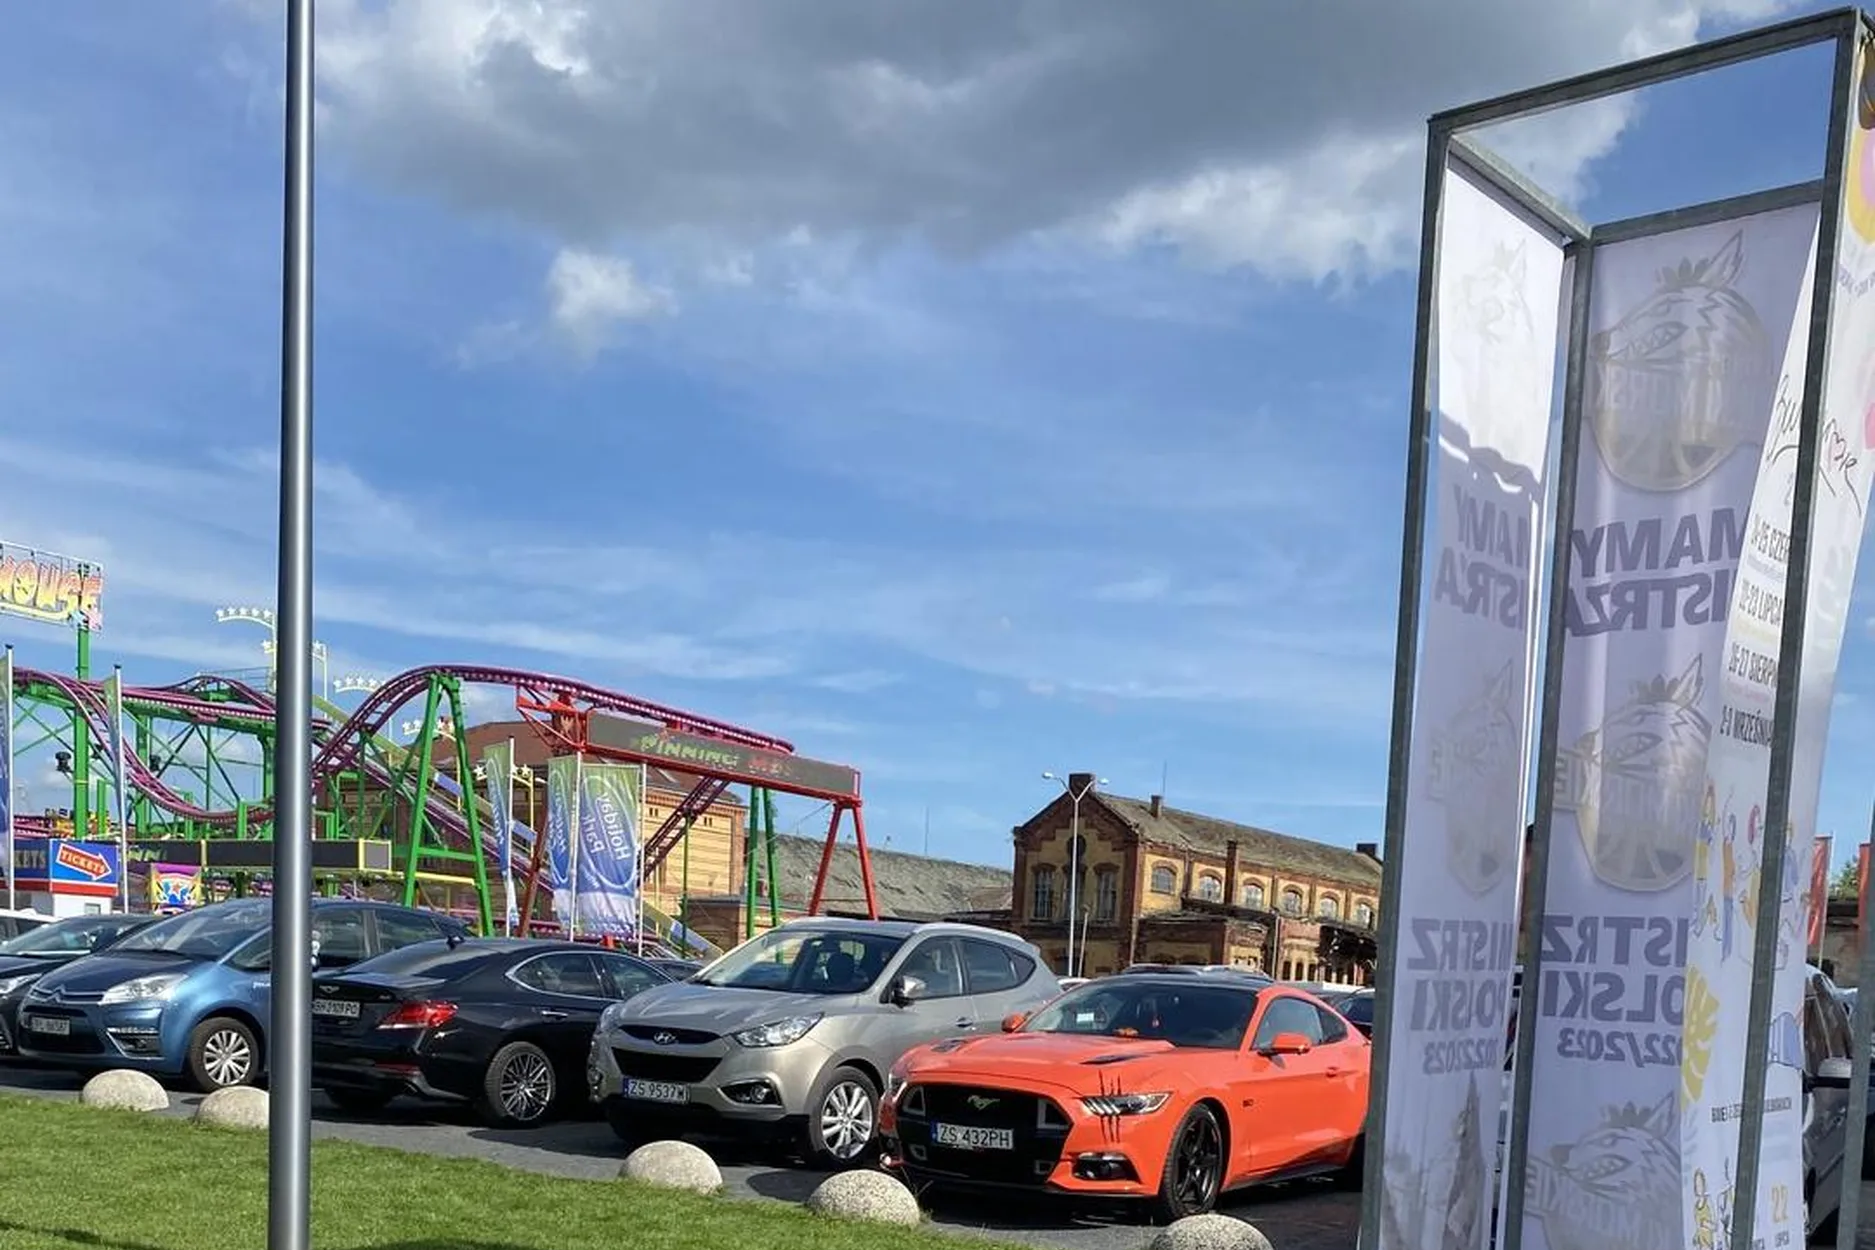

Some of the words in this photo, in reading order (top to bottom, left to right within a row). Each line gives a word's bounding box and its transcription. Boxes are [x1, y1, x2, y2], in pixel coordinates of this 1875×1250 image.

[59, 848, 106, 875] TICKETS
[630, 1081, 646, 1096] ZS
[940, 1125, 958, 1142] ZS
[962, 1129, 1010, 1148] 432PH
